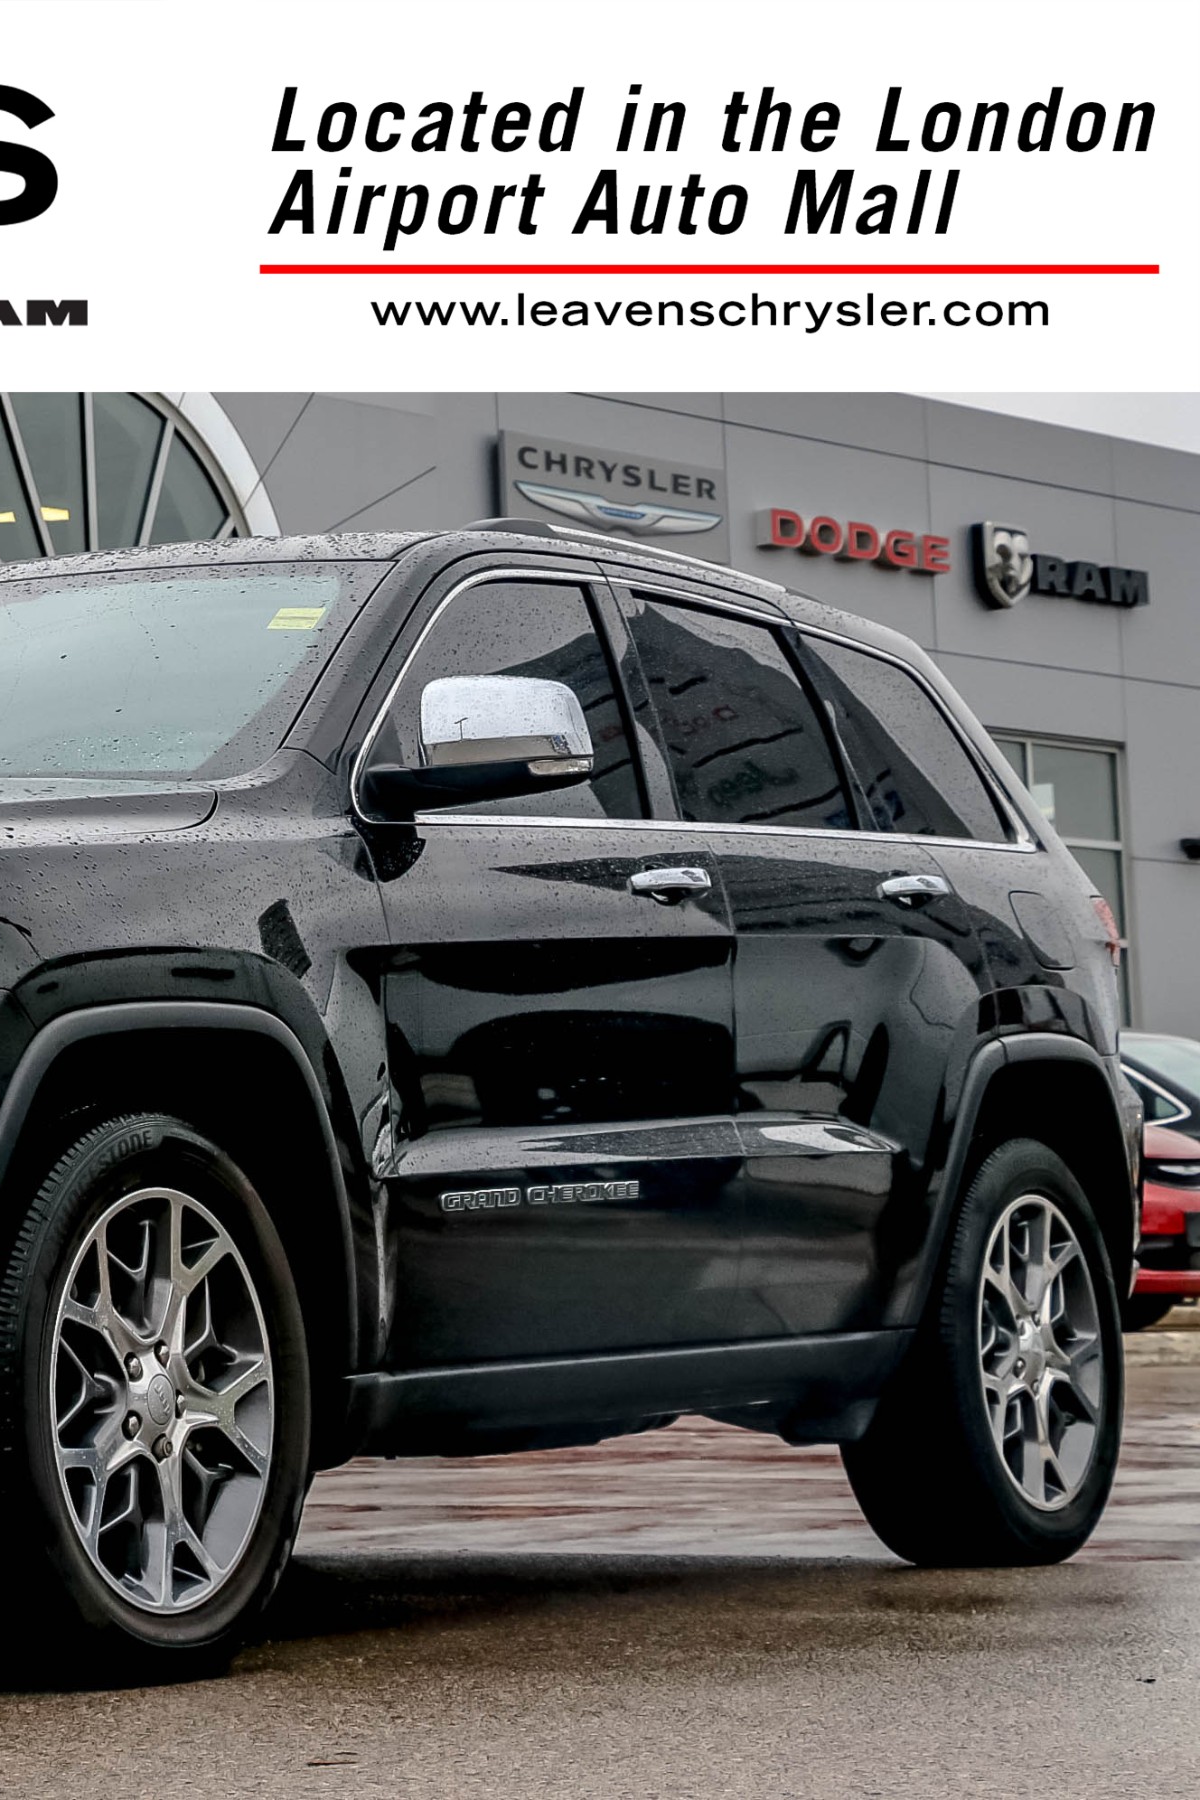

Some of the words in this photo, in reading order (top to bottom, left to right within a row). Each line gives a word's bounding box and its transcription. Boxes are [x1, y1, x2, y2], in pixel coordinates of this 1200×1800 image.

[517, 446, 717, 501] CHRYSLER
[769, 507, 952, 573] DODGE
[1031, 554, 1150, 607] RAM
[440, 1187, 522, 1212] GRAND
[526, 1180, 640, 1205] CHEROKEE
